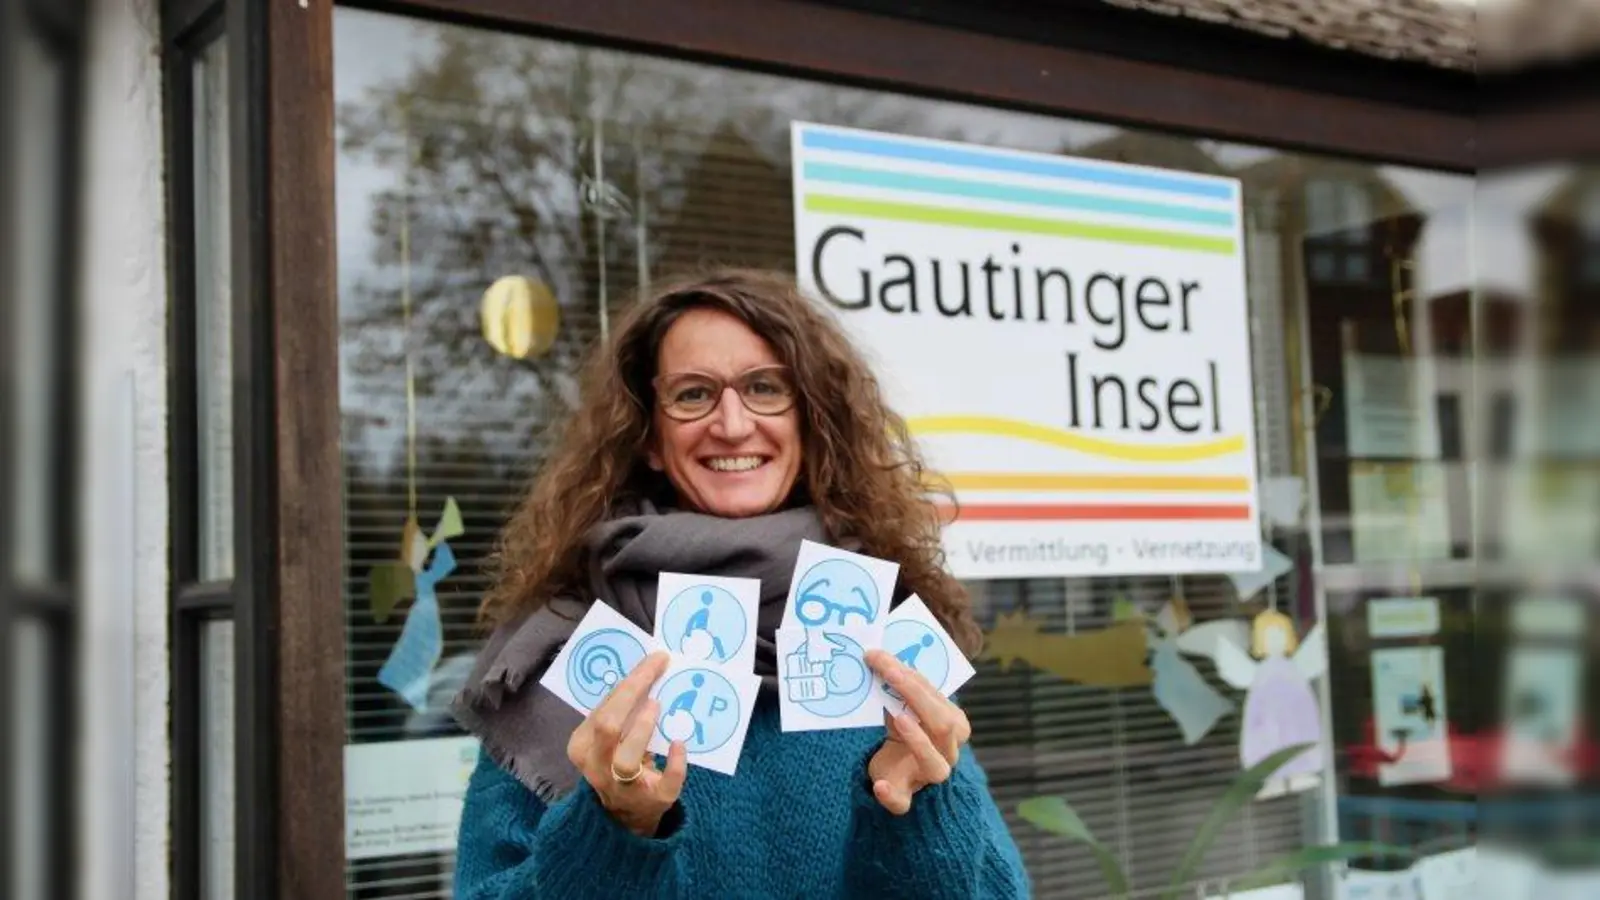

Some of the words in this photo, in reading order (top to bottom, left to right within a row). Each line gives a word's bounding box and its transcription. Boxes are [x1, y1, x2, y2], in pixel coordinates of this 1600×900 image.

[811, 224, 1200, 350] Gautinger
[1066, 352, 1222, 432] Insel
[966, 538, 1109, 567] Vermittlung
[1131, 538, 1257, 562] Vernetzung
[708, 695, 728, 717] P
